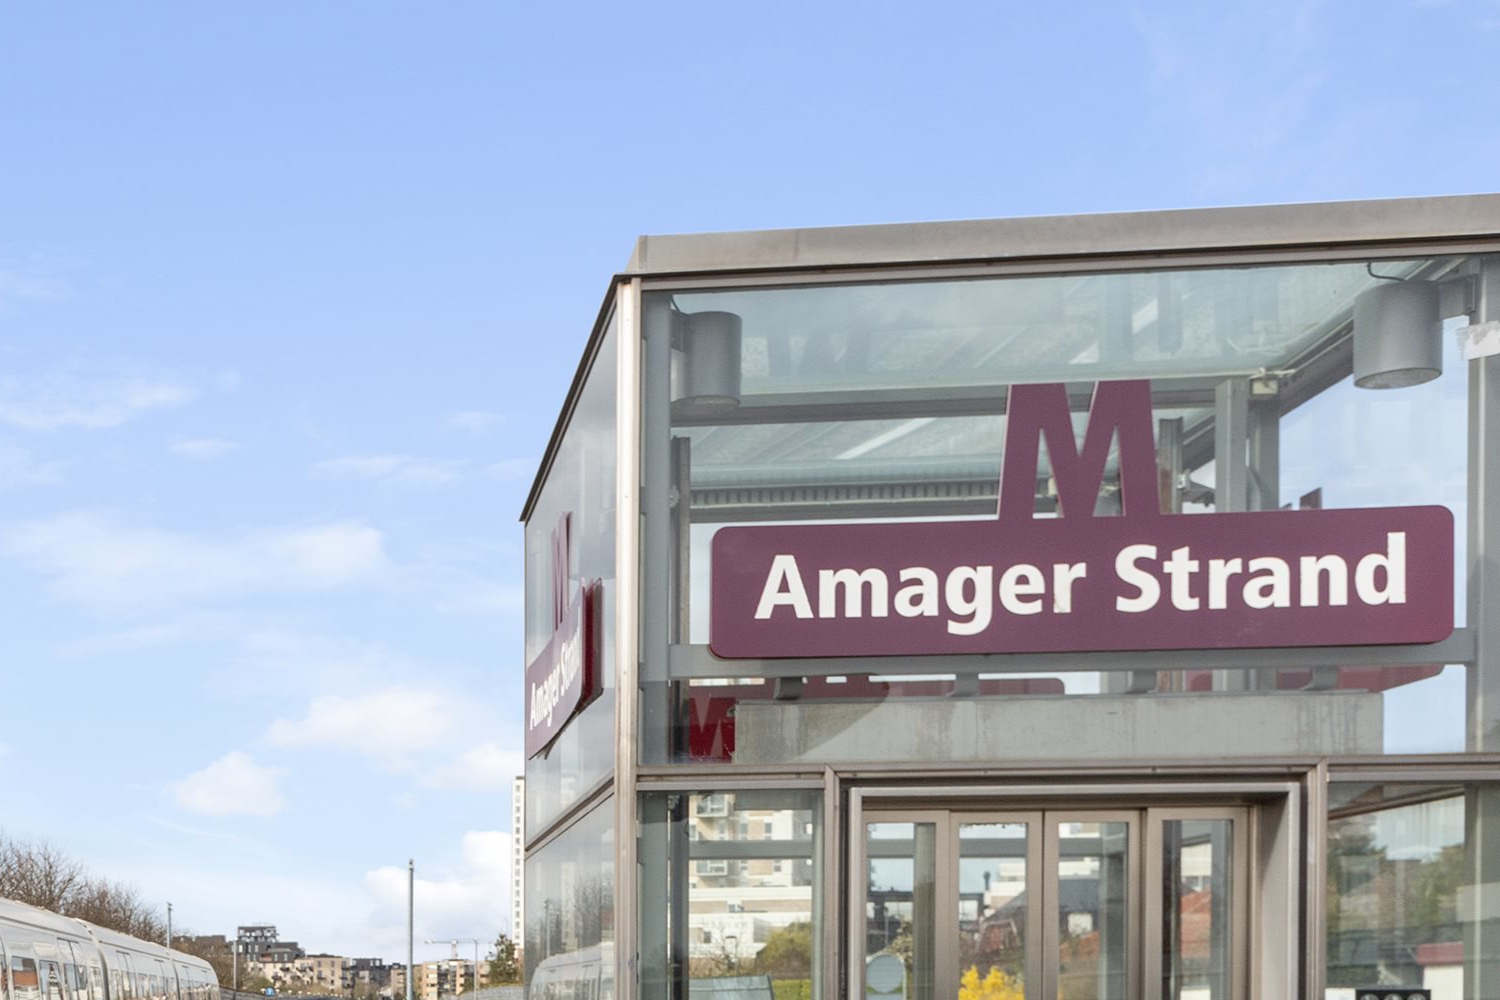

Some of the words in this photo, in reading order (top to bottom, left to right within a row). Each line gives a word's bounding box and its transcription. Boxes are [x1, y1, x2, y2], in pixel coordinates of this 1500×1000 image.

[997, 378, 1162, 520] M
[755, 554, 1085, 635] Amager
[1116, 532, 1405, 613] Strand
[529, 664, 560, 731] Amager
